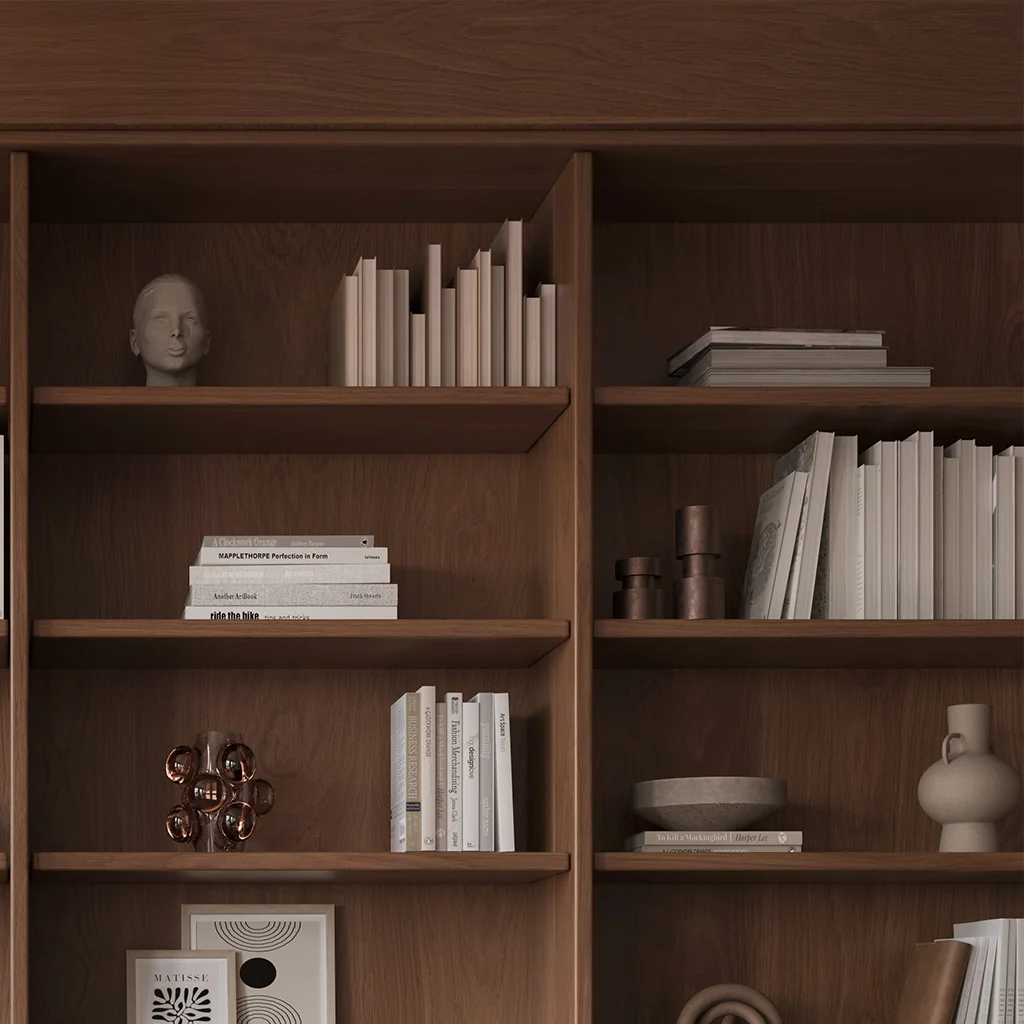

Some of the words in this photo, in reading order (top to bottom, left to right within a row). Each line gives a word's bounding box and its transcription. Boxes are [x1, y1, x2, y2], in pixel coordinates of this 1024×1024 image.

[212, 537, 218, 546] A
[218, 537, 252, 546] Clockwork
[254, 537, 277, 546] Orange
[210, 612, 226, 620] ride
[228, 612, 240, 620] the
[408, 715, 417, 754] BUSINESS
[452, 720, 460, 745] Fashion
[449, 746, 460, 794] Merchandising
[408, 756, 417, 799] RESEARCH
[450, 798, 458, 810] James
[686, 833, 728, 843] Mockingbird
[735, 834, 757, 843] Harper
[154, 974, 209, 982] MATISSE
